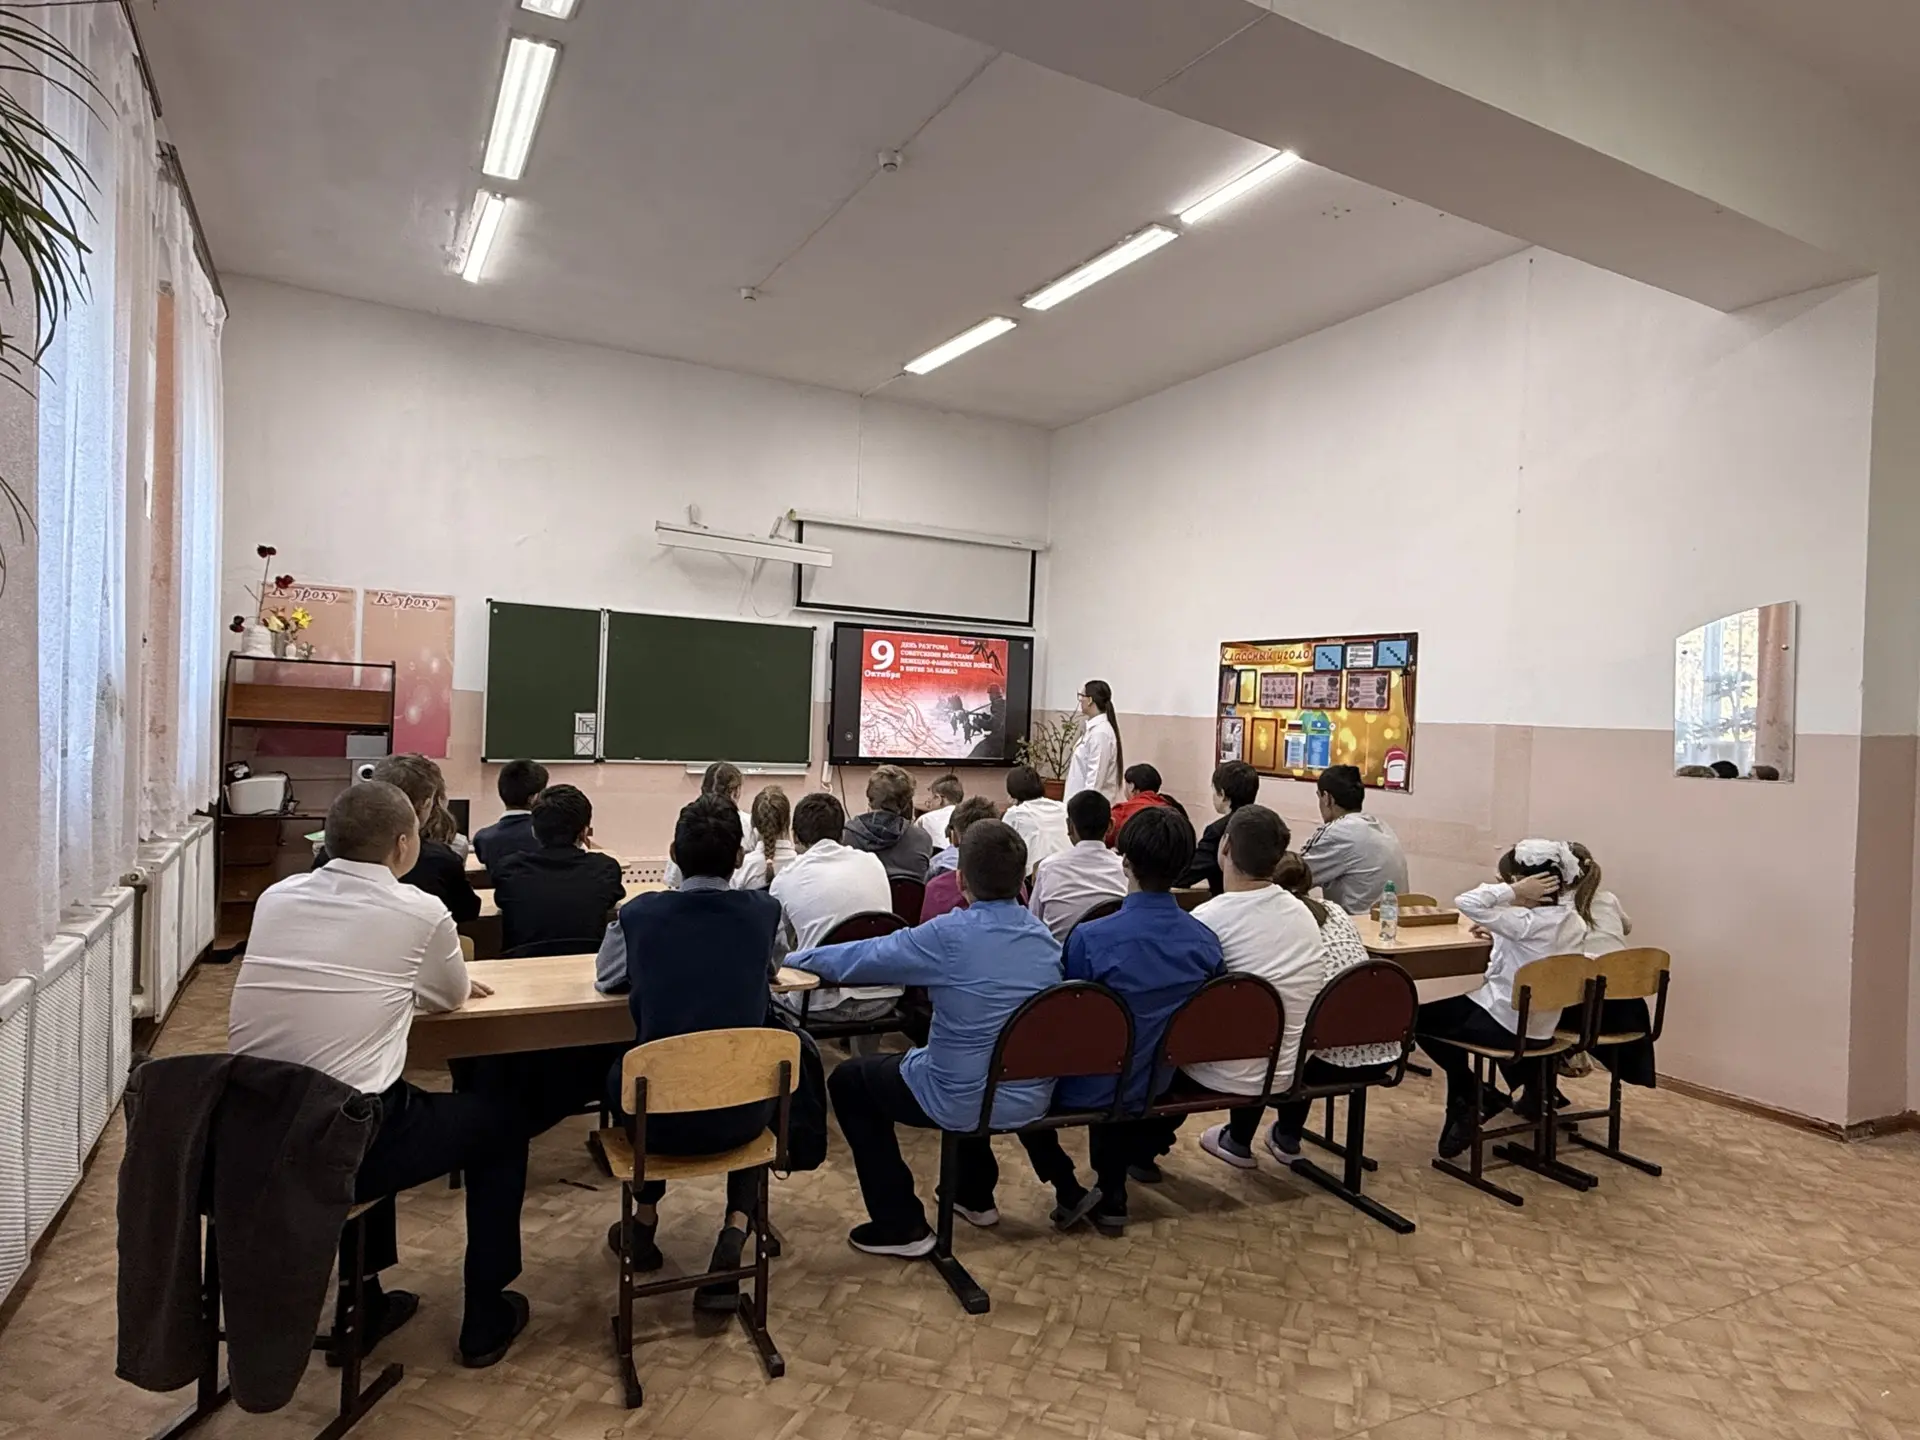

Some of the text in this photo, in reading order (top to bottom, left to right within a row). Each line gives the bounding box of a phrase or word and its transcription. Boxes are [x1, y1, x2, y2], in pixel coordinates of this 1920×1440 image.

[293, 587, 338, 602] уроку
[376, 592, 438, 610] К уроку
[900, 641, 948, 651] ДЕНЬ РАЗГРОМА
[870, 639, 895, 670] 9
[900, 650, 975, 660] СОВЕТСКИМИ ВОЙСКАМИ
[1222, 647, 1312, 663] Классный уголо
[973, 661, 993, 669] ВОЙСК
[864, 670, 901, 680] Октября
[935, 667, 958, 675] КАВКАЗ
